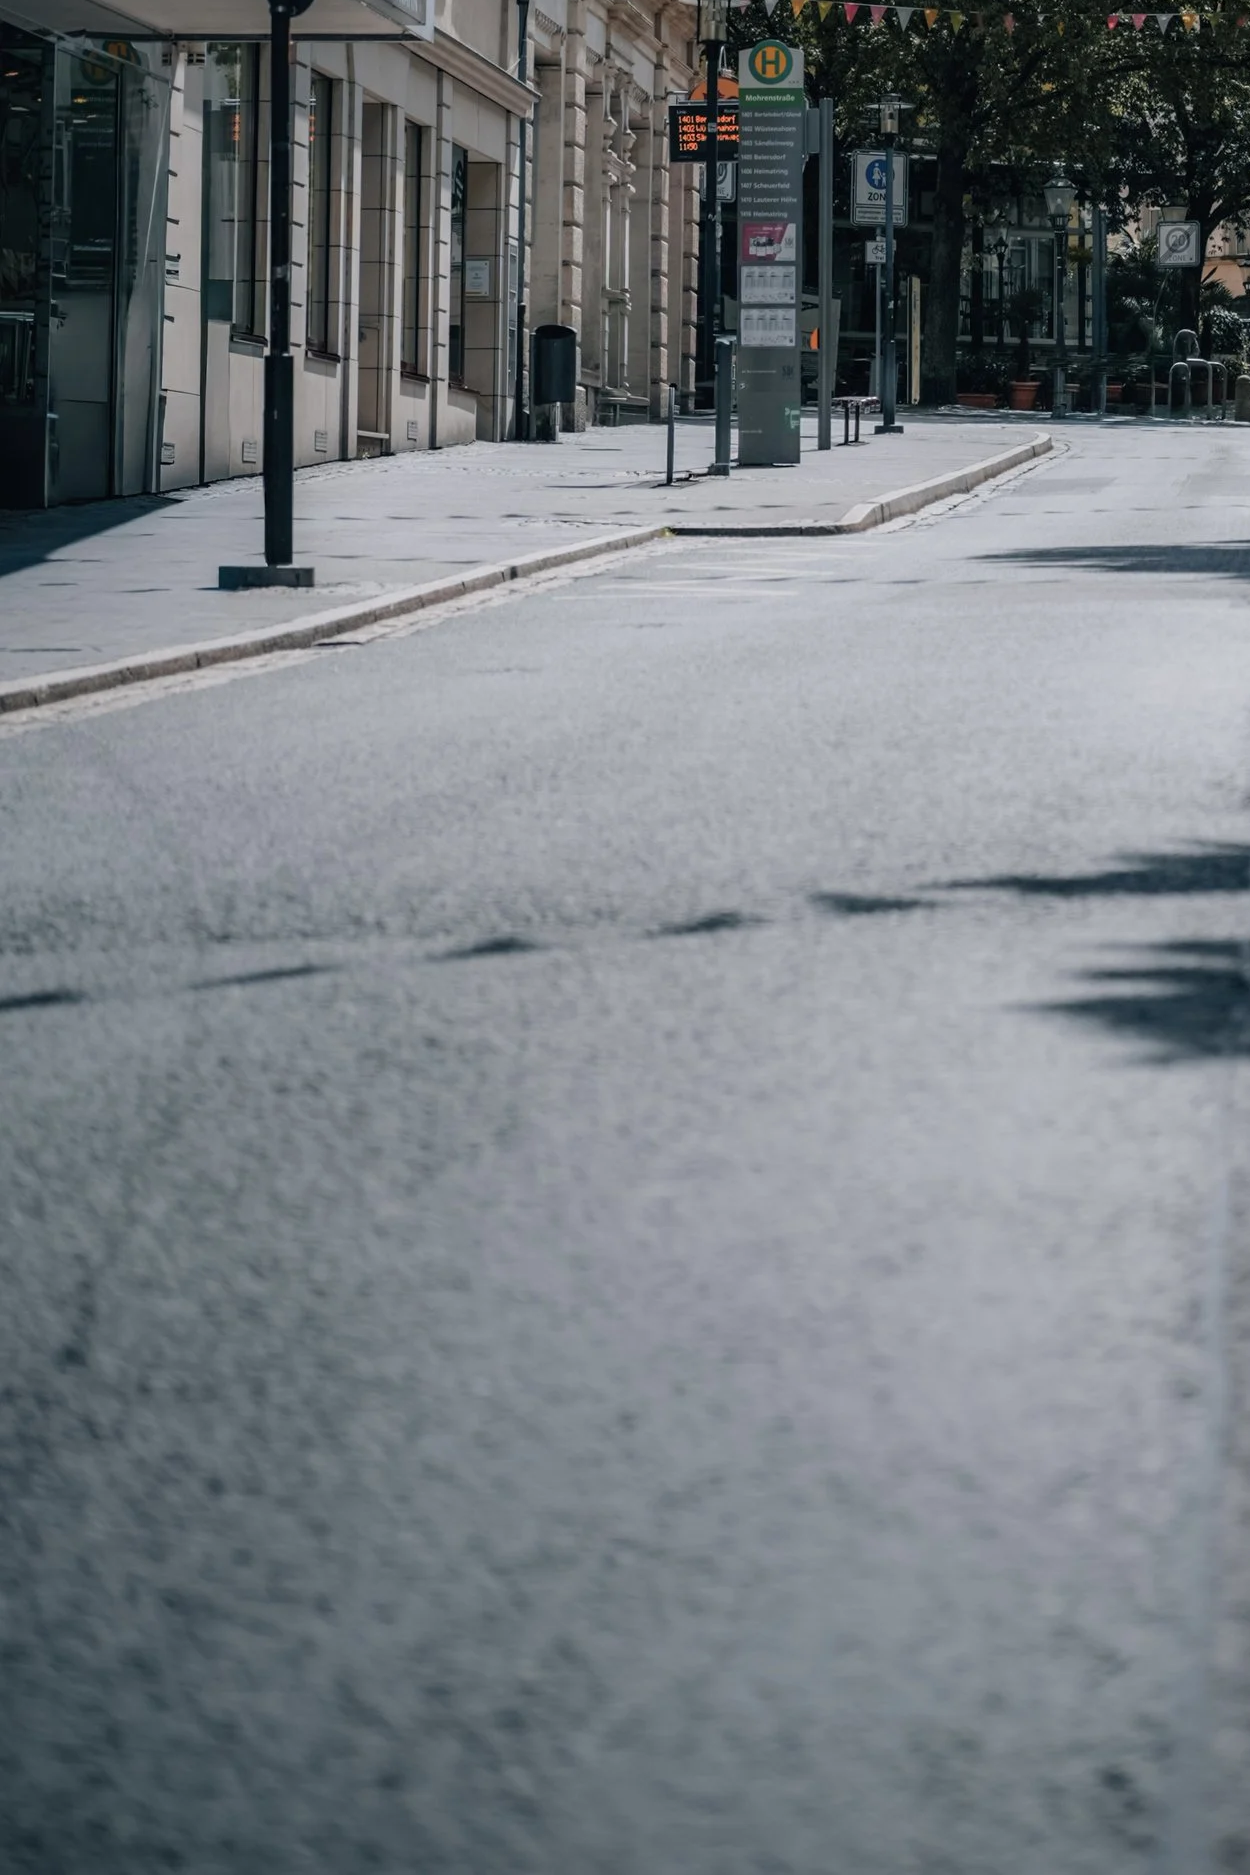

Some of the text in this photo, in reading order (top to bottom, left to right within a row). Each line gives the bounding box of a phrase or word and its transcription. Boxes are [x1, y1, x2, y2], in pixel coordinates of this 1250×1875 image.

[761, 51, 780, 74] H
[745, 94, 796, 102] Mohrenstraße
[679, 115, 694, 124] 1401
[679, 125, 694, 133] 1402
[679, 133, 695, 142] 1403
[867, 192, 887, 201] ZON
[1172, 234, 1185, 246] 20
